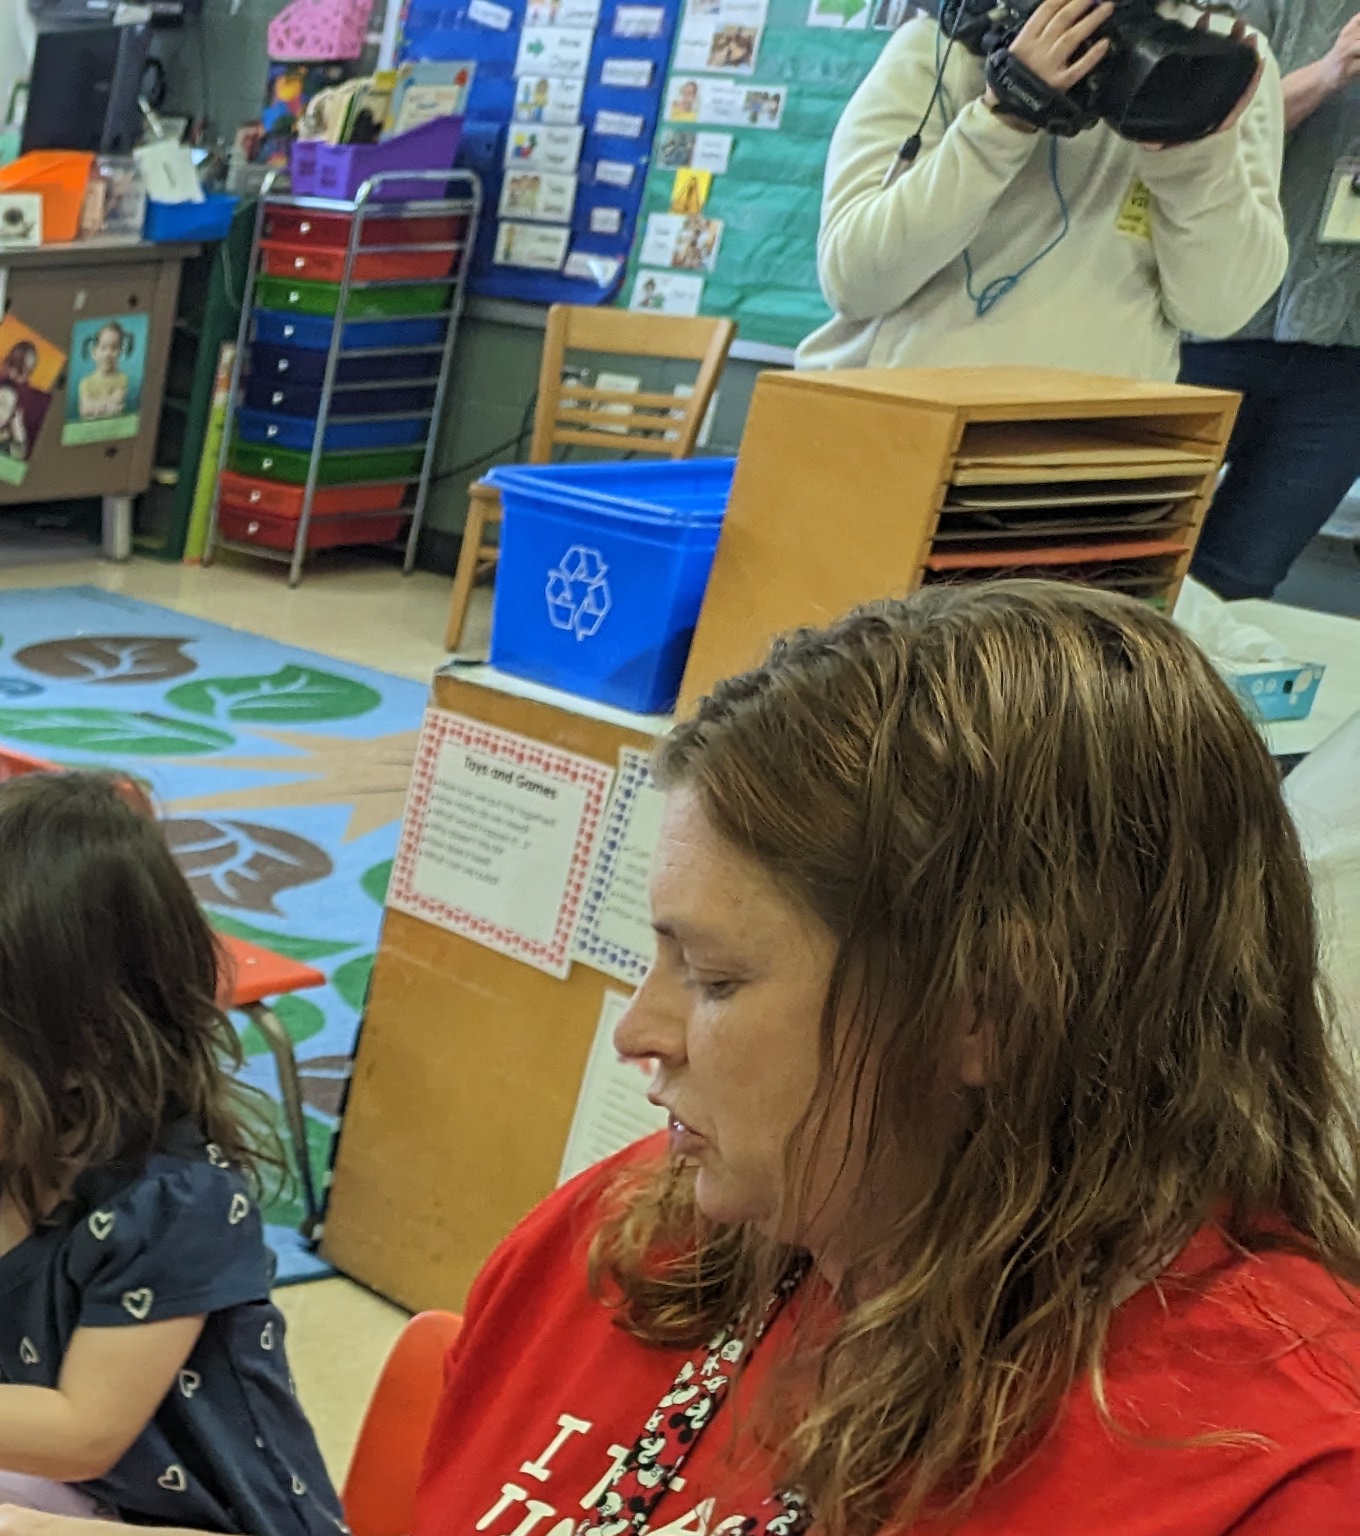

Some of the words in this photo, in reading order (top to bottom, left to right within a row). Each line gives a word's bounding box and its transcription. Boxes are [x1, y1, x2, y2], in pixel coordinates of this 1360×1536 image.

[464, 755, 488, 776] Toys
[490, 766, 514, 784] and
[516, 773, 557, 799] Games
[519, 1413, 593, 1482] I
